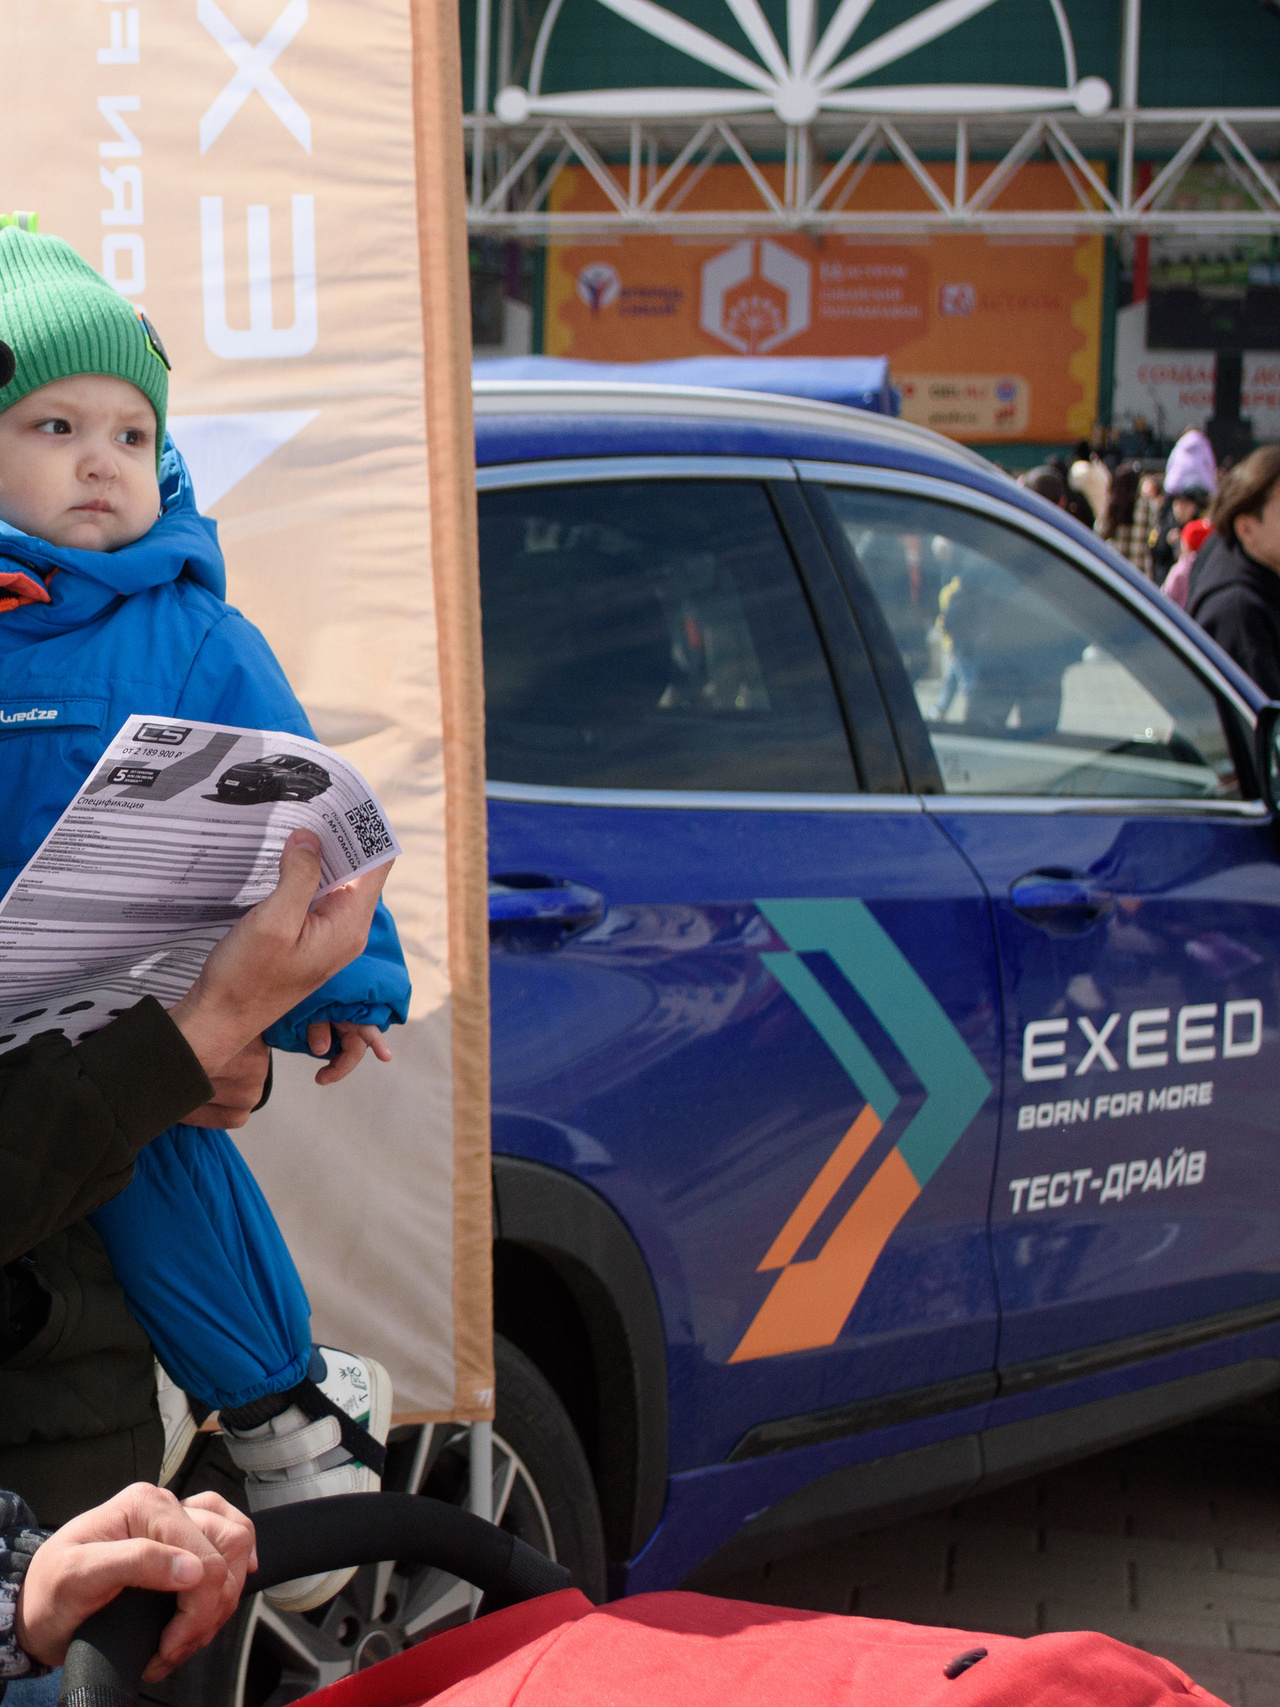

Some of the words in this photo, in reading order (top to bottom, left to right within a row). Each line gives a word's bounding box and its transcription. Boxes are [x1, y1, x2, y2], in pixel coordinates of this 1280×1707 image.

[133, 747, 142, 755] 2
[142, 748, 159, 757] 189
[157, 750, 175, 759] 900
[113, 769, 129, 782] 5
[77, 797, 145, 810] Спецификация
[337, 835, 358, 871] OMODA
[1022, 999, 1263, 1082] EXEED
[1018, 1098, 1090, 1131] BORN
[1093, 1090, 1144, 1120] FOR
[1147, 1081, 1214, 1113] MORE
[1008, 1146, 1207, 1214] ТЕСТ-ДРАЙВ
